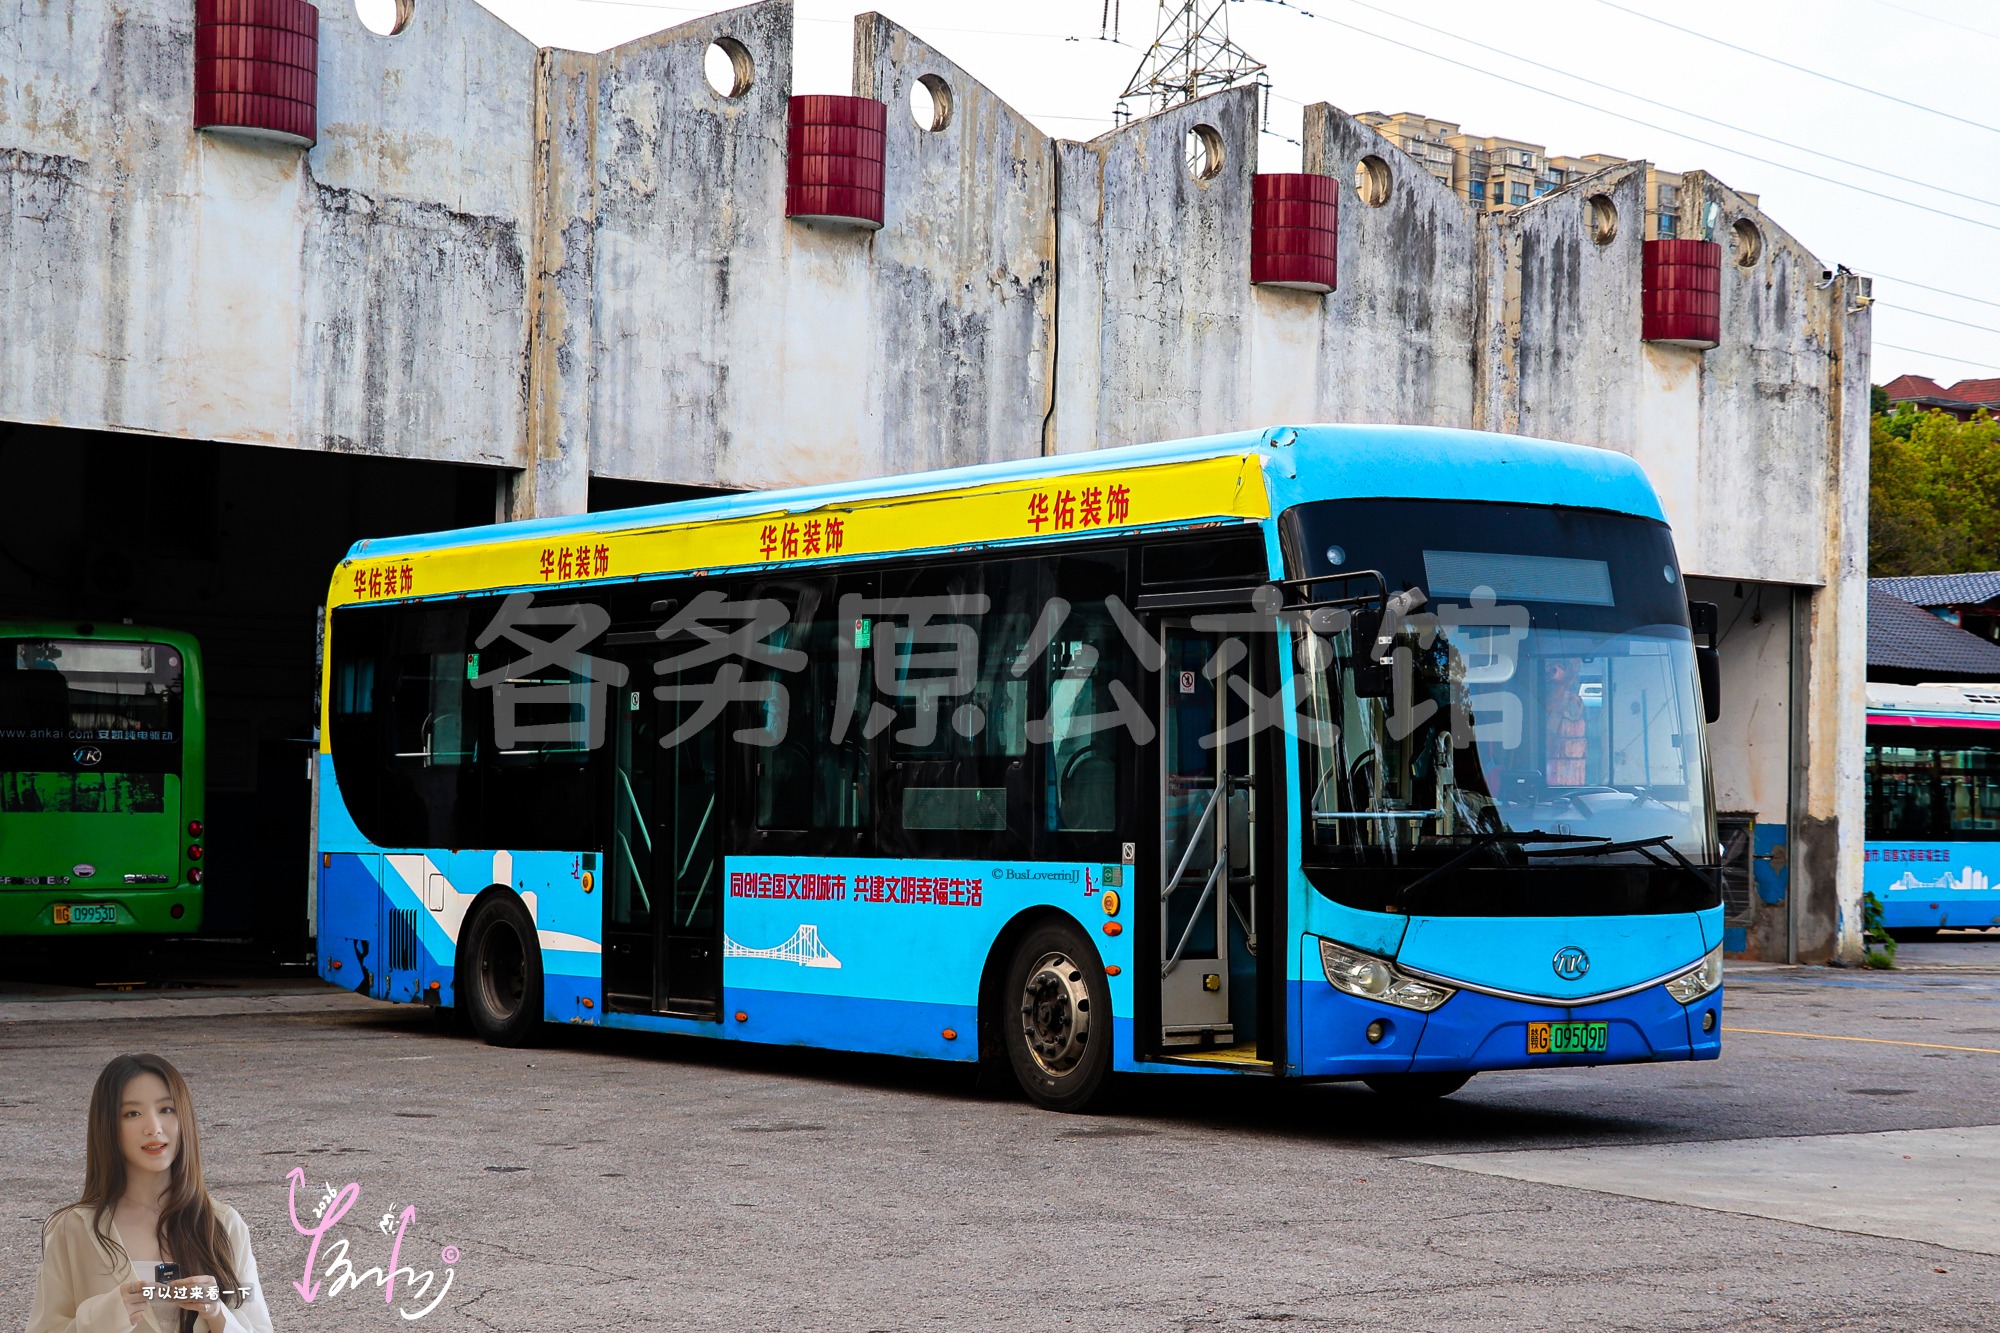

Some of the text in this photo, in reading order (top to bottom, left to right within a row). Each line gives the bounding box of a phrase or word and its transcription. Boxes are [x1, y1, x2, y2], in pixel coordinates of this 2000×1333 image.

[1028, 485, 1130, 532] 华佑装饰
[760, 518, 844, 561] 华佑装饰
[540, 545, 609, 581] 华佑装饰
[354, 566, 413, 599] 华佑装饰
[97, 730, 173, 741] 安凯纯电驱动
[731, 873, 982, 906] 同创全国文明城市 共建文明幸福生活
